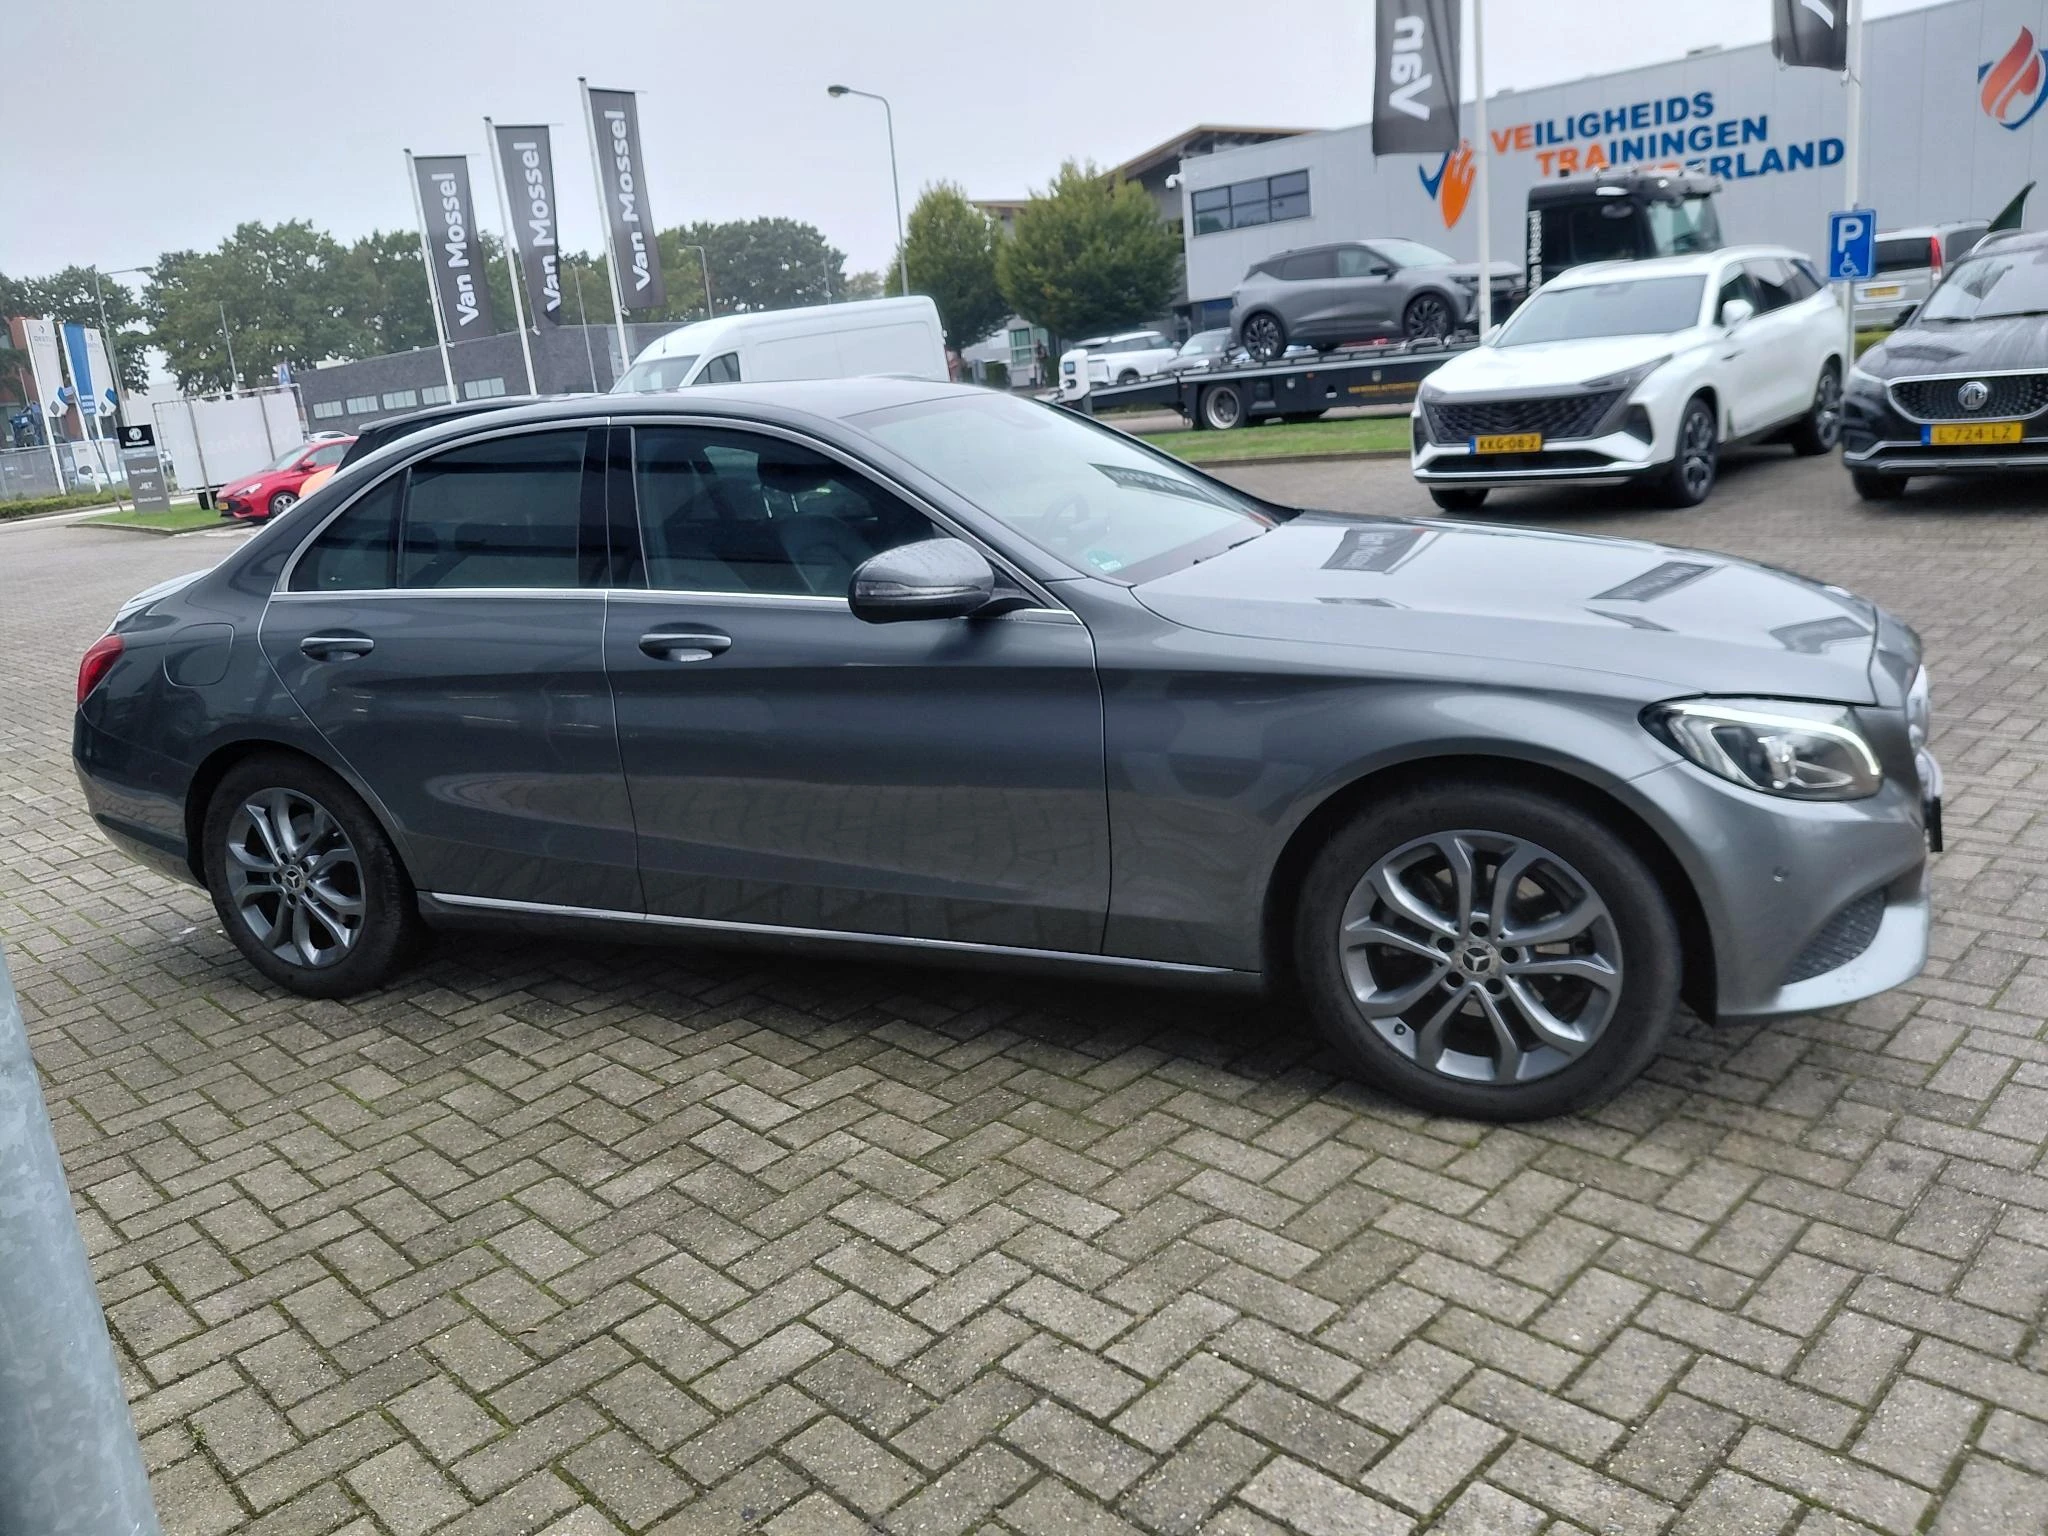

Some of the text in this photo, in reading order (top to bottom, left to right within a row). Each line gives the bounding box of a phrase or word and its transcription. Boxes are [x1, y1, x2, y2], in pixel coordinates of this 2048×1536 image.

[1389, 16, 1432, 121] Van
[1490, 91, 1714, 155] VEILIGHEIDS
[1536, 114, 1767, 176] TRAININGEN
[513, 142, 561, 312] Van Mossel
[604, 110, 650, 291] Van Mossel
[1527, 209, 1541, 264] Mossel
[1838, 217, 1864, 253] P
[432, 172, 479, 326] Van Mossel
